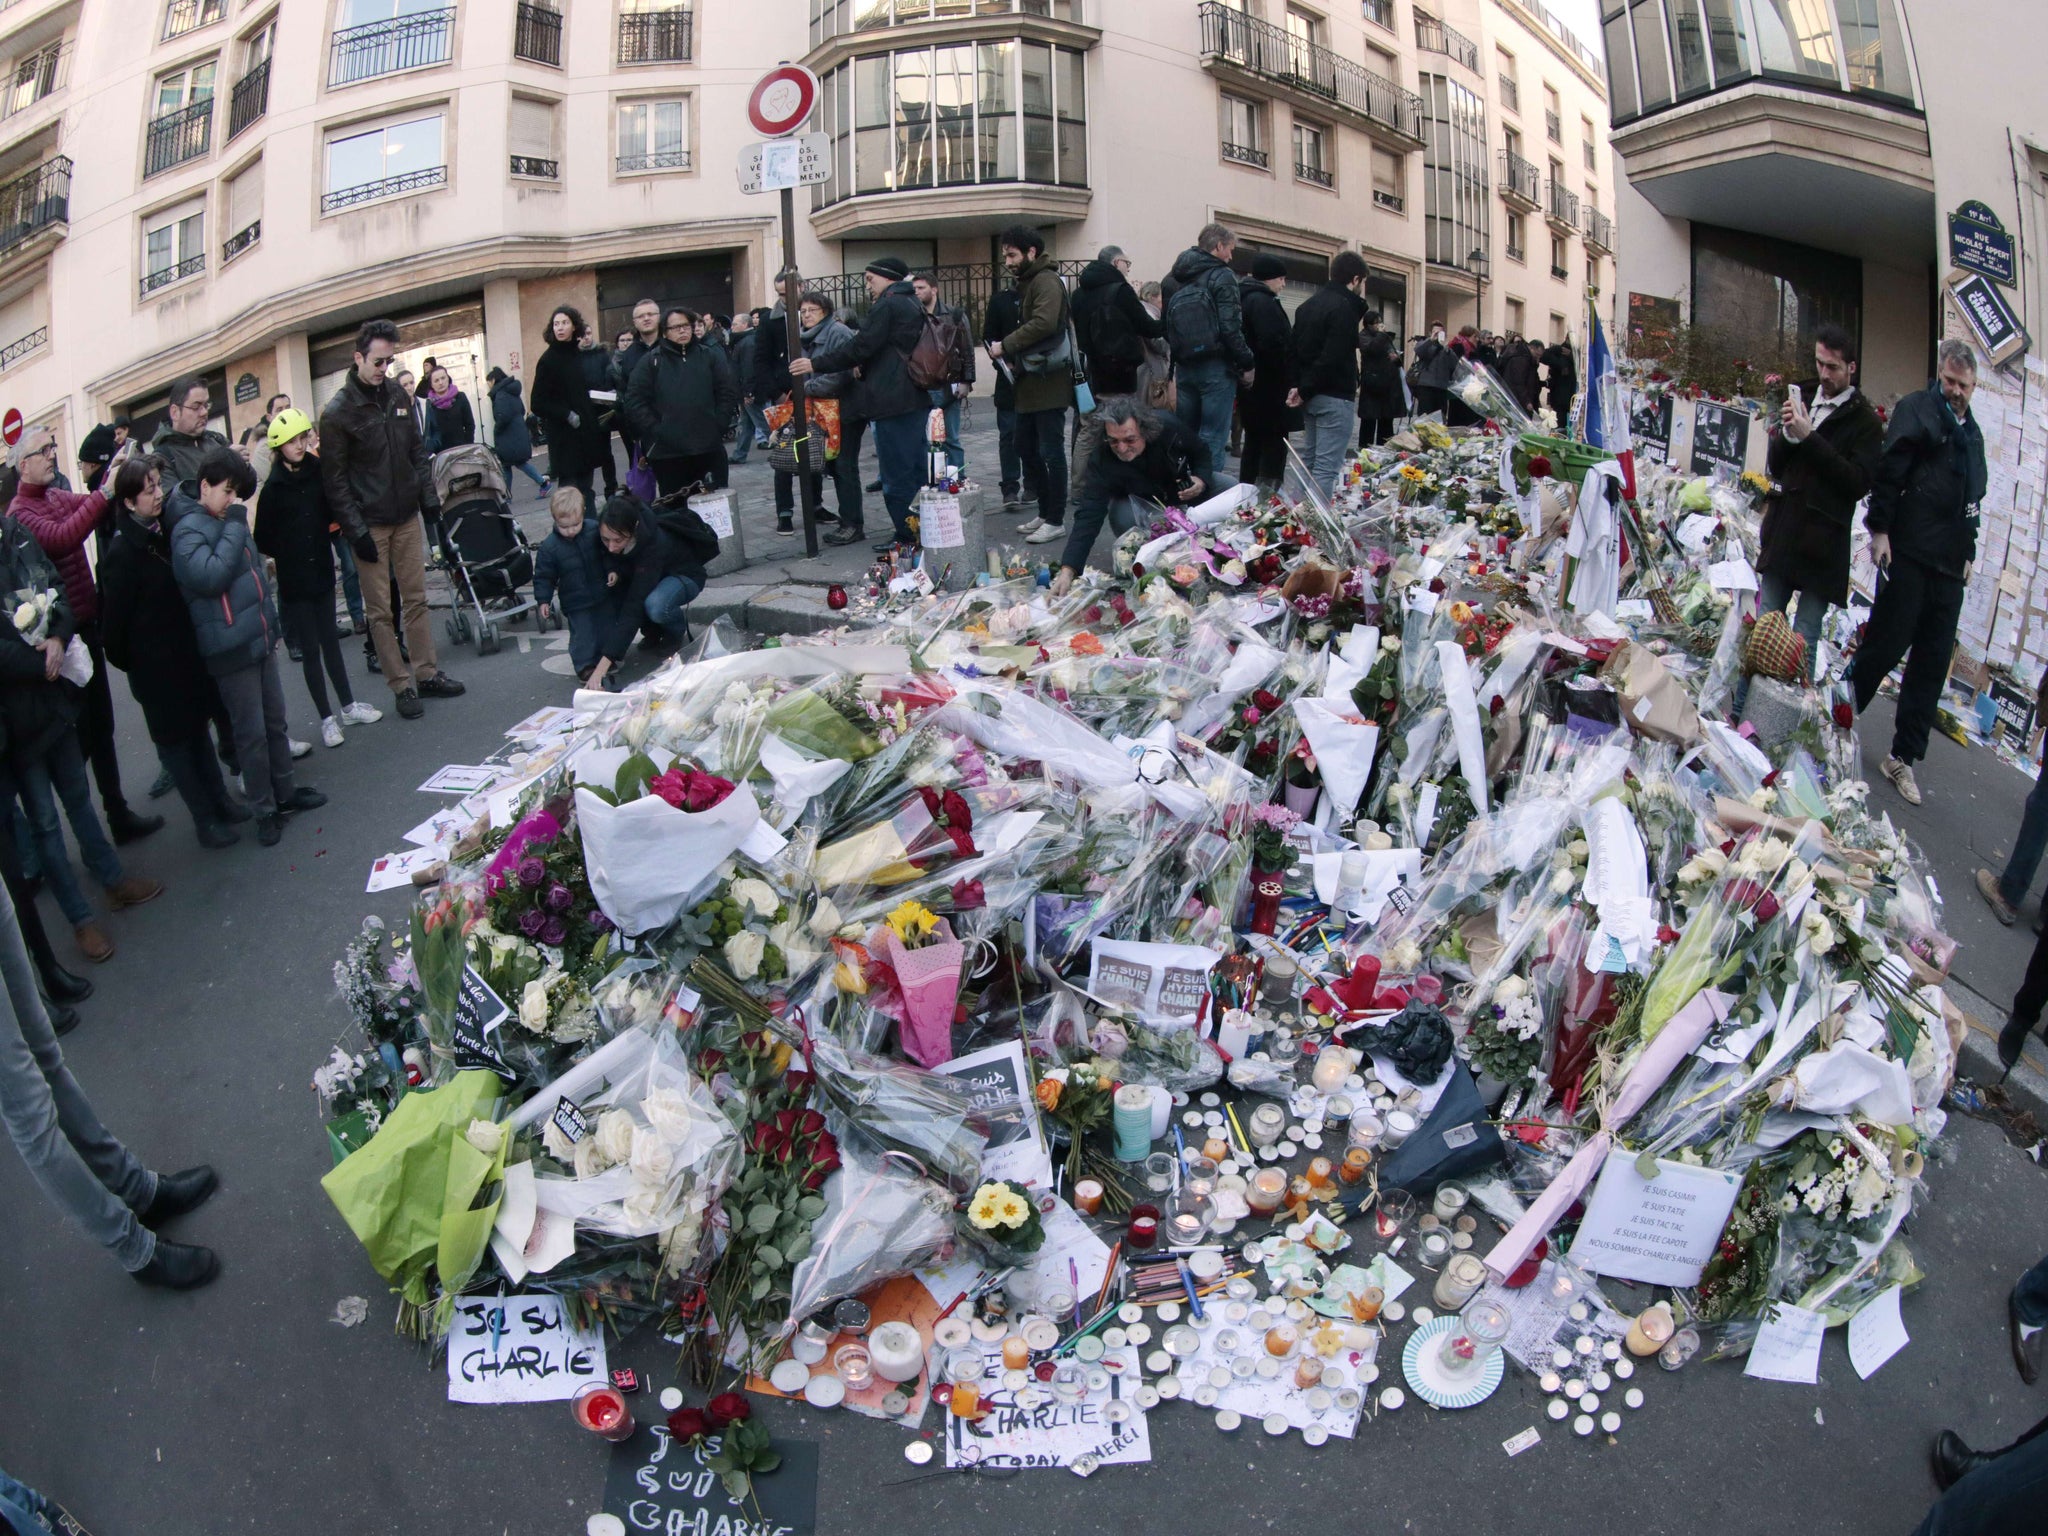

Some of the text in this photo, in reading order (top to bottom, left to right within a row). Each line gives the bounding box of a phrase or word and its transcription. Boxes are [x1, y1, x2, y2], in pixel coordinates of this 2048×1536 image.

[803, 164, 814, 172] ET
[806, 154, 819, 163] DE
[744, 183, 756, 191] DE
[1954, 234, 2010, 260] NICOLAS APPERT
[1974, 232, 1990, 243] RUE
[1967, 293, 1999, 337] CHARLIE
[1974, 290, 1987, 303] JE
[1984, 304, 2004, 331] SUIS
[1995, 696, 2027, 719] JE SUIS
[1996, 705, 2026, 730] HARLIE
[1100, 964, 1149, 980] JE SUIS
[1166, 973, 1206, 984] JE SUIS
[1100, 971, 1146, 994] CHARLIE
[1166, 982, 1206, 994] HYPER
[470, 986, 488, 1003] des
[455, 1028, 481, 1051] Porte
[481, 1044, 495, 1058] de
[560, 1101, 587, 1129] JE SUIS
[555, 1110, 584, 1142] CHARLIE
[1643, 1184, 1697, 1202] JE SUIS CASIMIR
[1641, 1201, 1687, 1217] JE SUIS TATIE
[1630, 1215, 1685, 1232] JE SUIS TAC TAC
[1613, 1227, 1621, 1235] JE
[1622, 1229, 1638, 1239] SUIS
[1639, 1232, 1647, 1241] LA
[1661, 1237, 1688, 1249] CAPOTE
[1588, 1238, 1702, 1266] NOUS SOMMES CHARLIE'S ANGELS
[461, 1338, 596, 1383] CHARLIE
[988, 1453, 1061, 1467] TODAY
